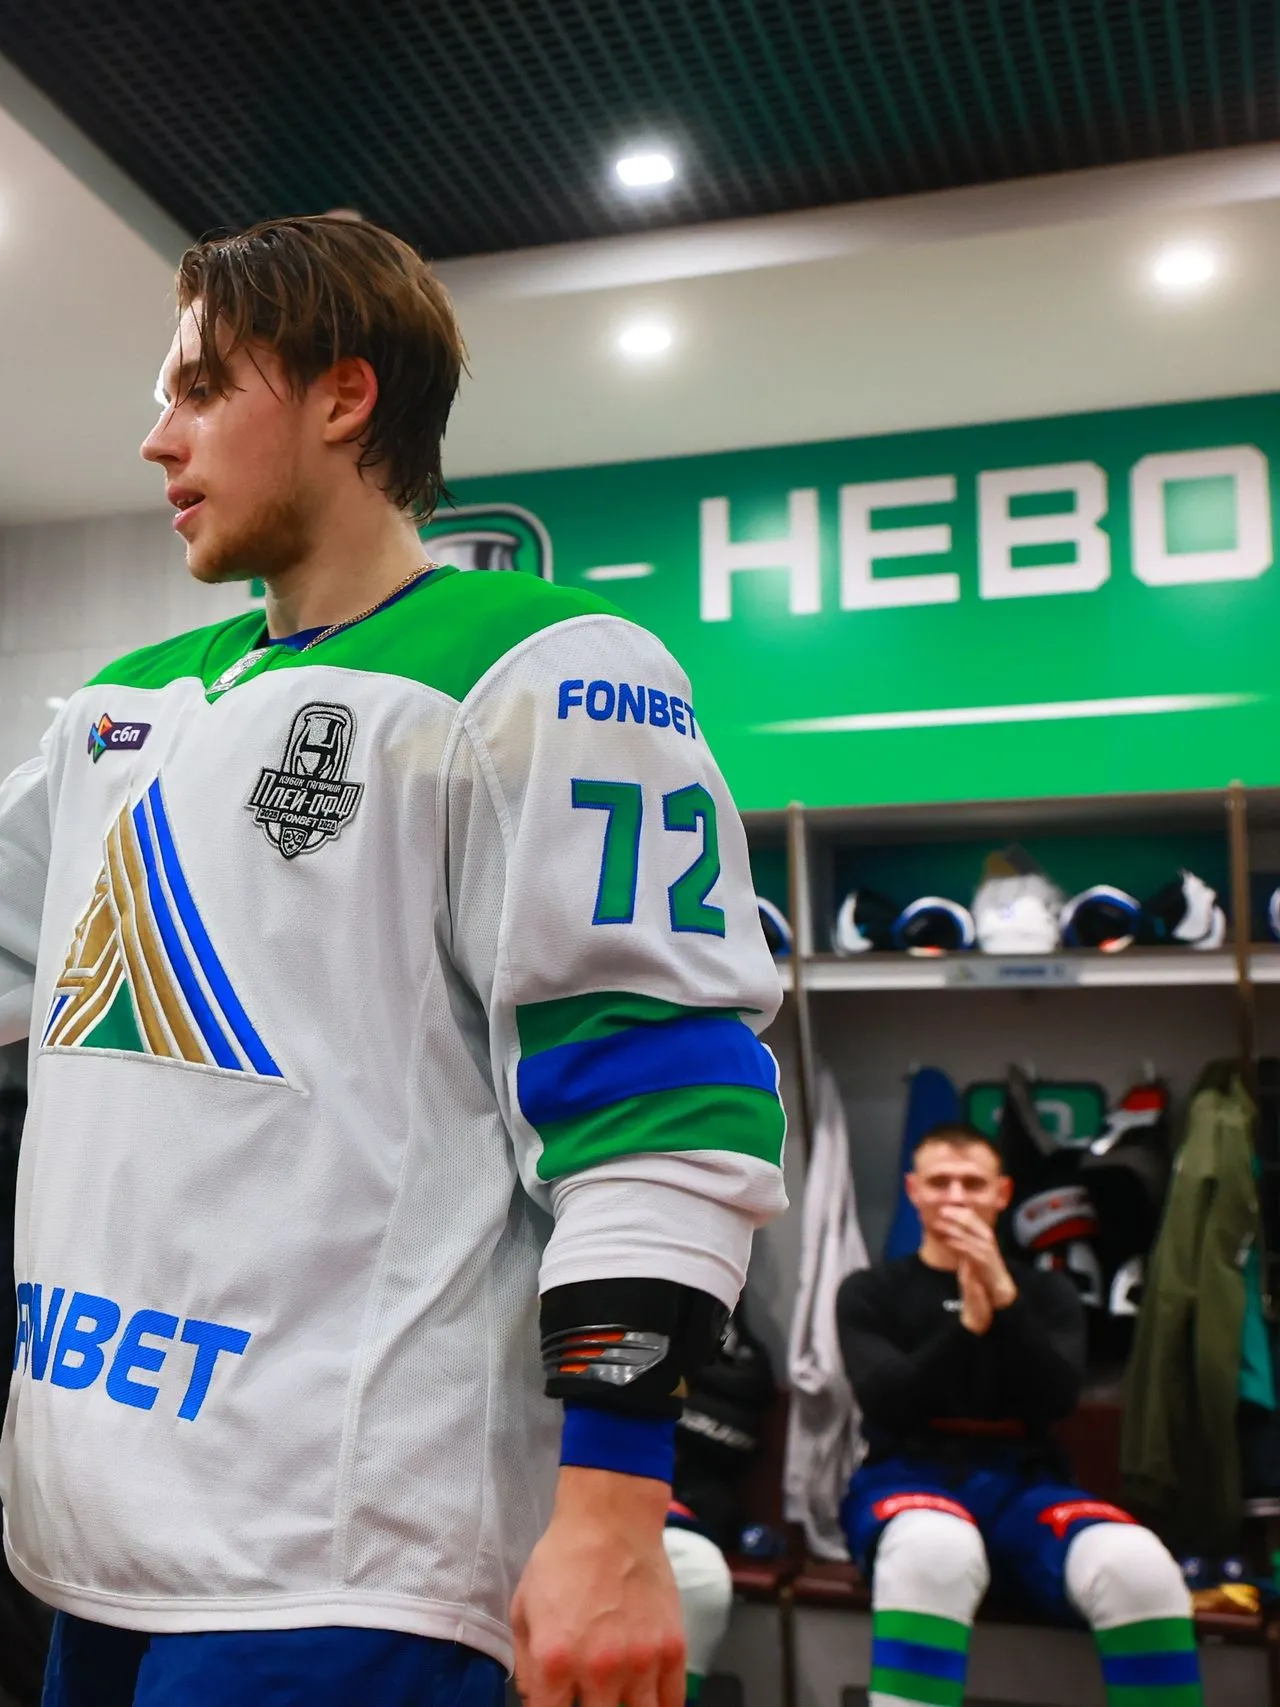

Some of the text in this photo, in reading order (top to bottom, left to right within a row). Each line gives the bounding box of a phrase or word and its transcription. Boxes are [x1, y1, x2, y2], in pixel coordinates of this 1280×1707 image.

[699, 443, 1274, 622] НЕВО
[557, 679, 696, 740] FONBET
[278, 774, 305, 788] КУБОК
[278, 811, 318, 828] FONBET
[570, 778, 725, 939] 72
